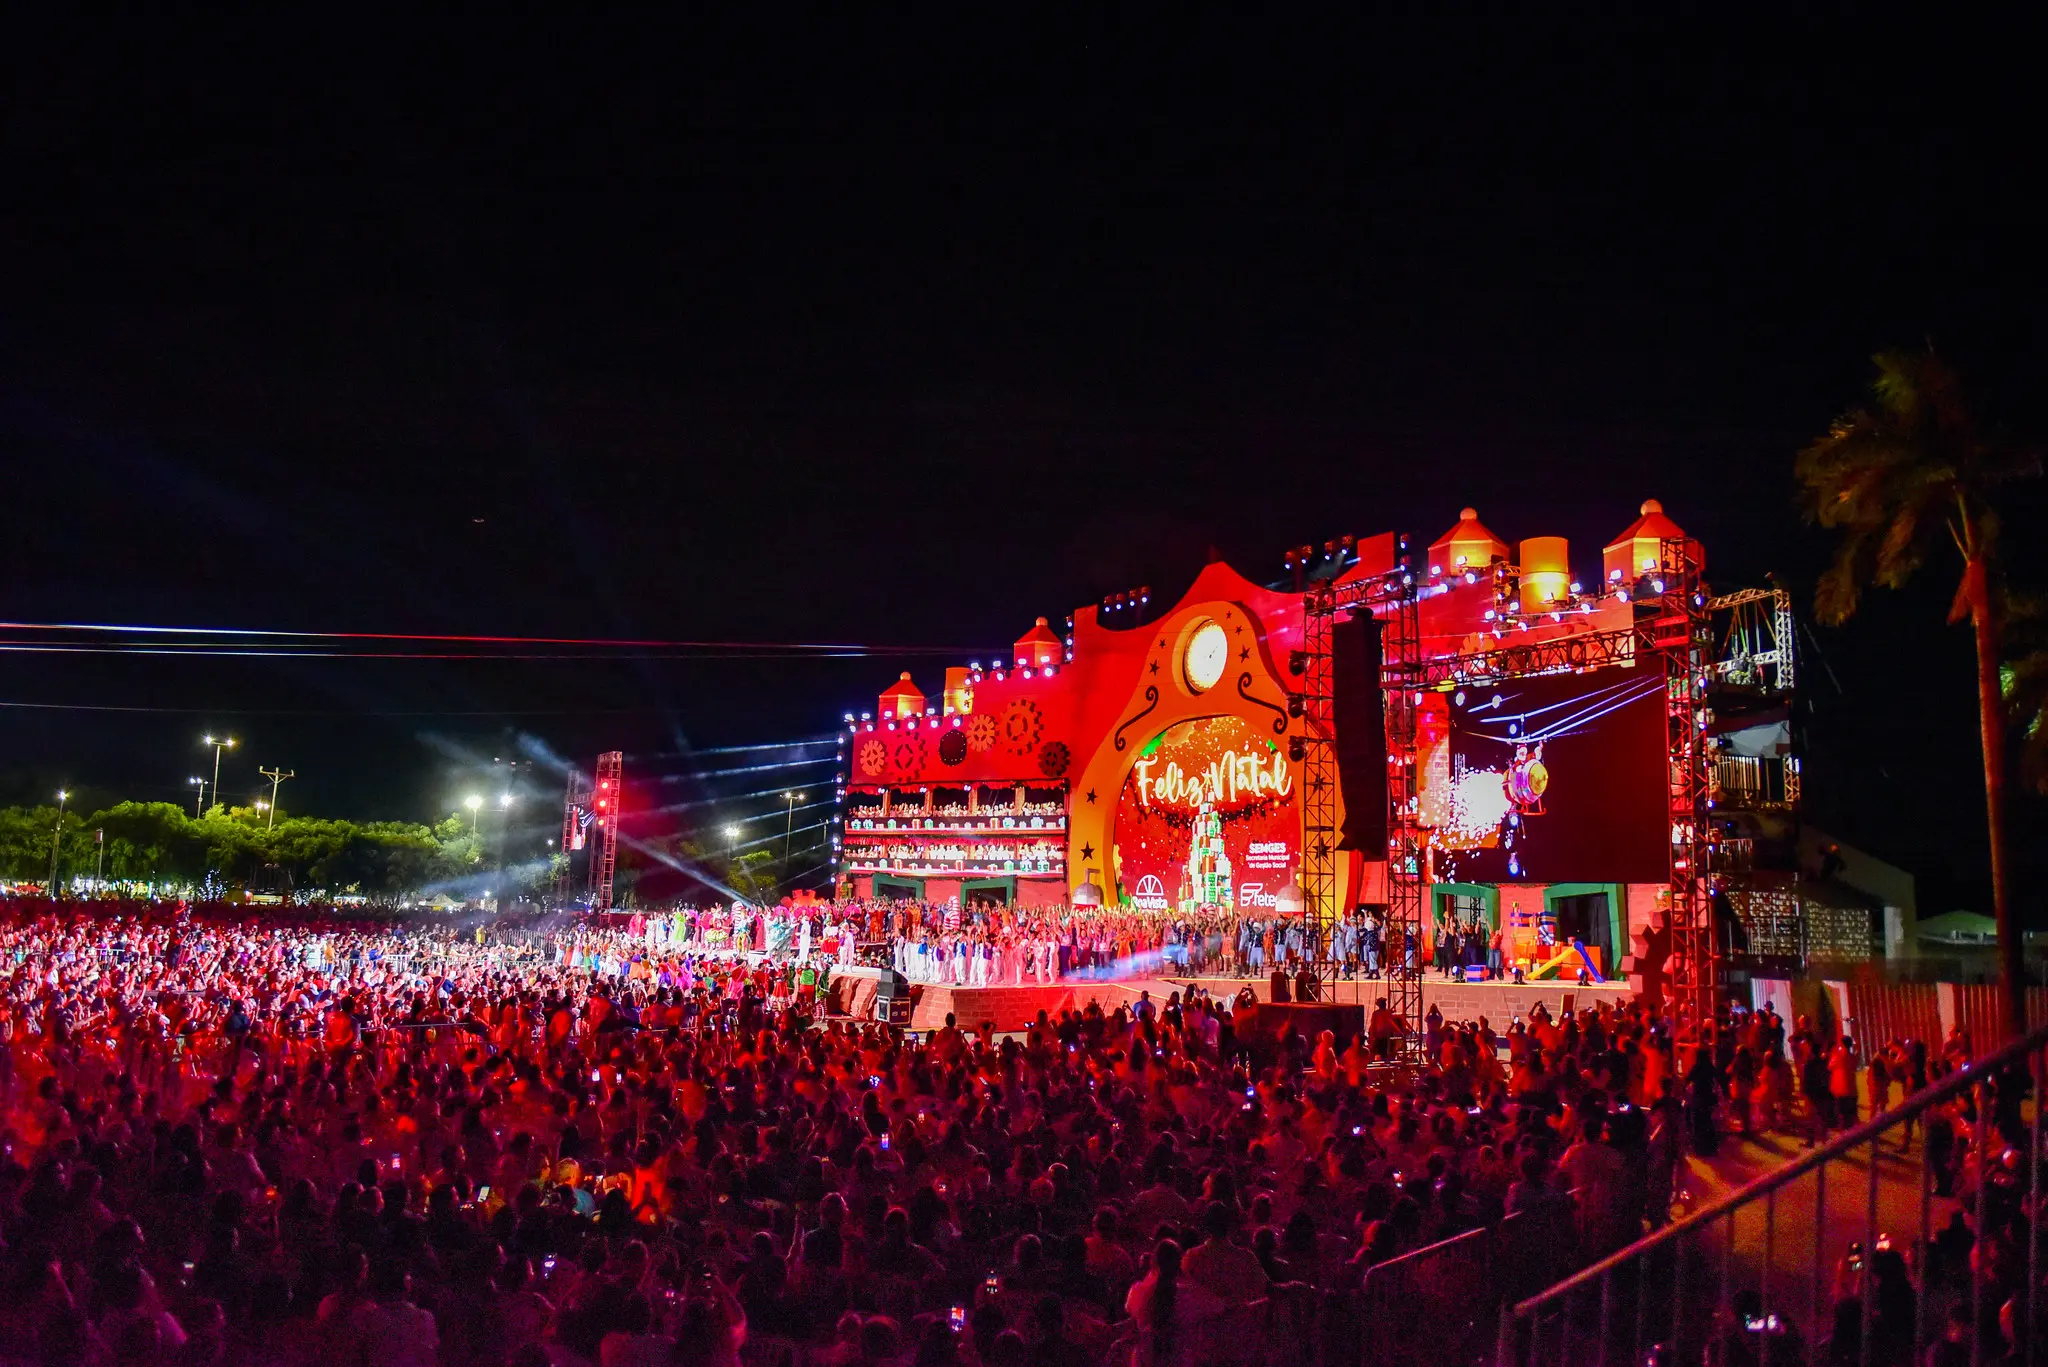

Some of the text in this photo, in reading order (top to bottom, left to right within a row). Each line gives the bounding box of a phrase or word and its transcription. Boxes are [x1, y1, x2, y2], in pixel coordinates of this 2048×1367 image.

[1135, 750, 1292, 807] Feliz Natal
[1249, 842, 1286, 854] SEMGES
